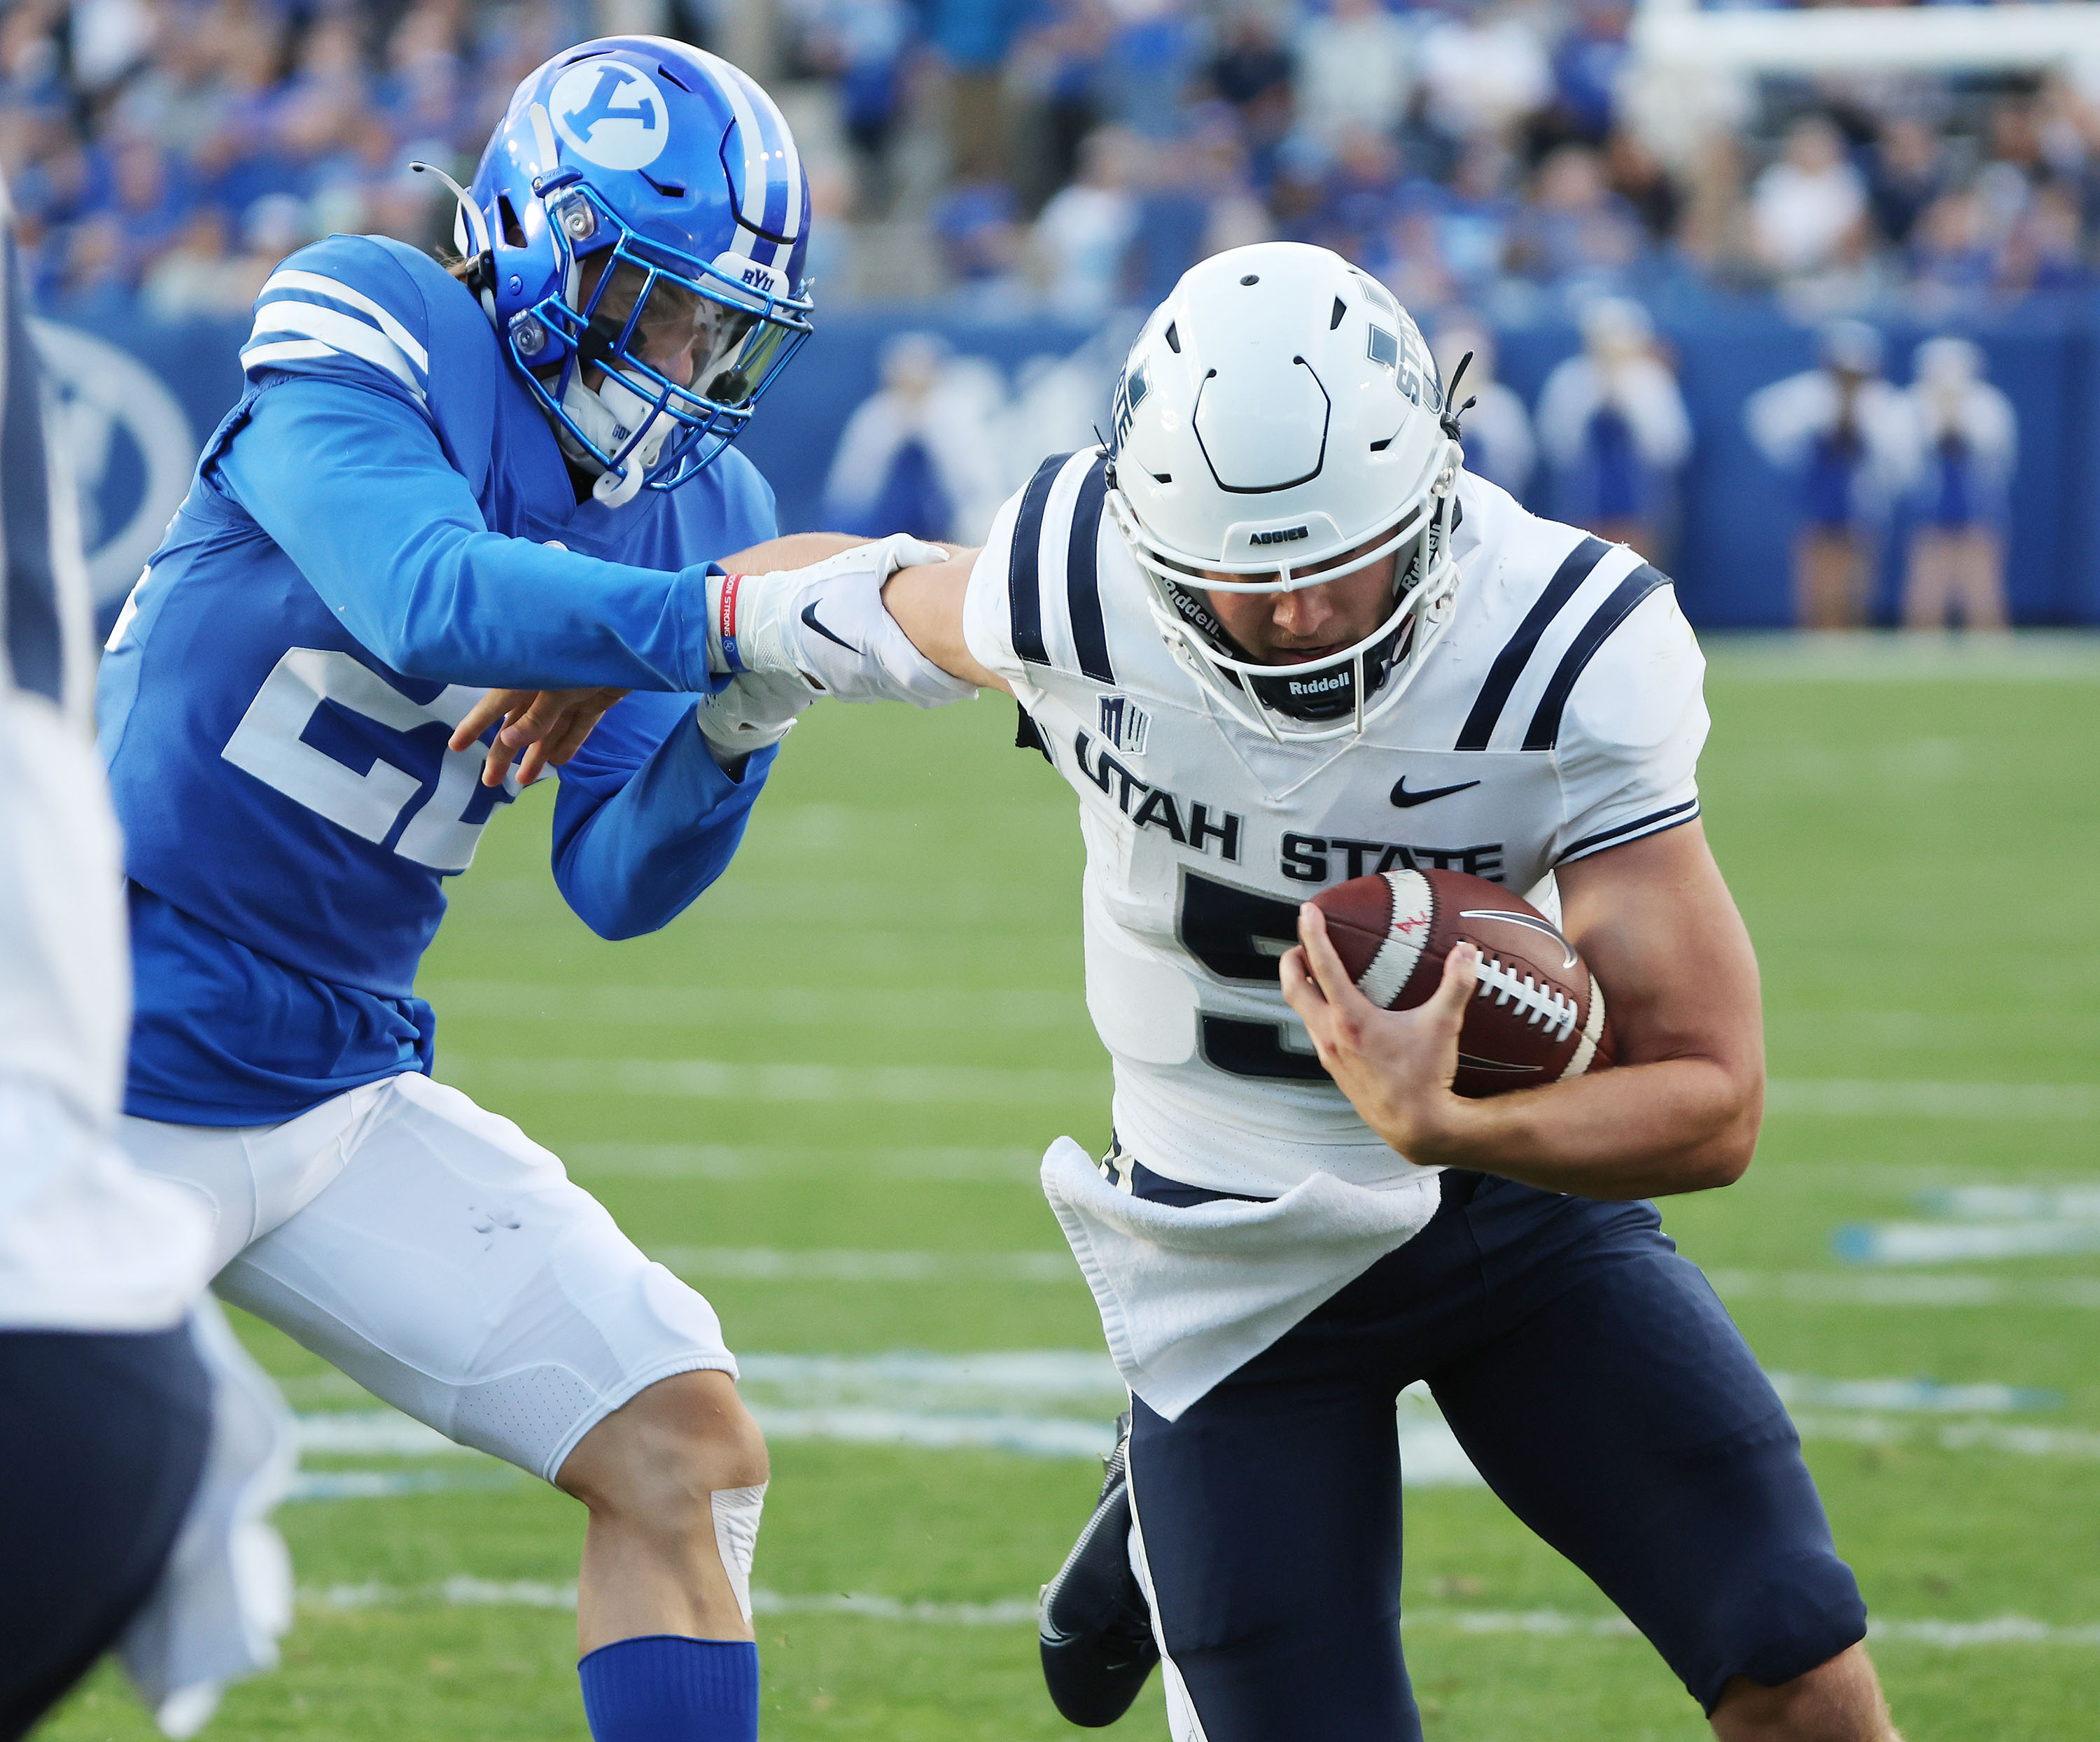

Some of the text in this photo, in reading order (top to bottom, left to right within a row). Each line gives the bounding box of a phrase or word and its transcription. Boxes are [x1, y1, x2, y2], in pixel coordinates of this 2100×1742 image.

[741, 268, 775, 292] BYU
[1249, 524, 1309, 545] AGGIES
[723, 596, 732, 637] STRONG
[1289, 671, 1350, 695] Riddell
[1074, 726, 1504, 883] UTAH STATE
